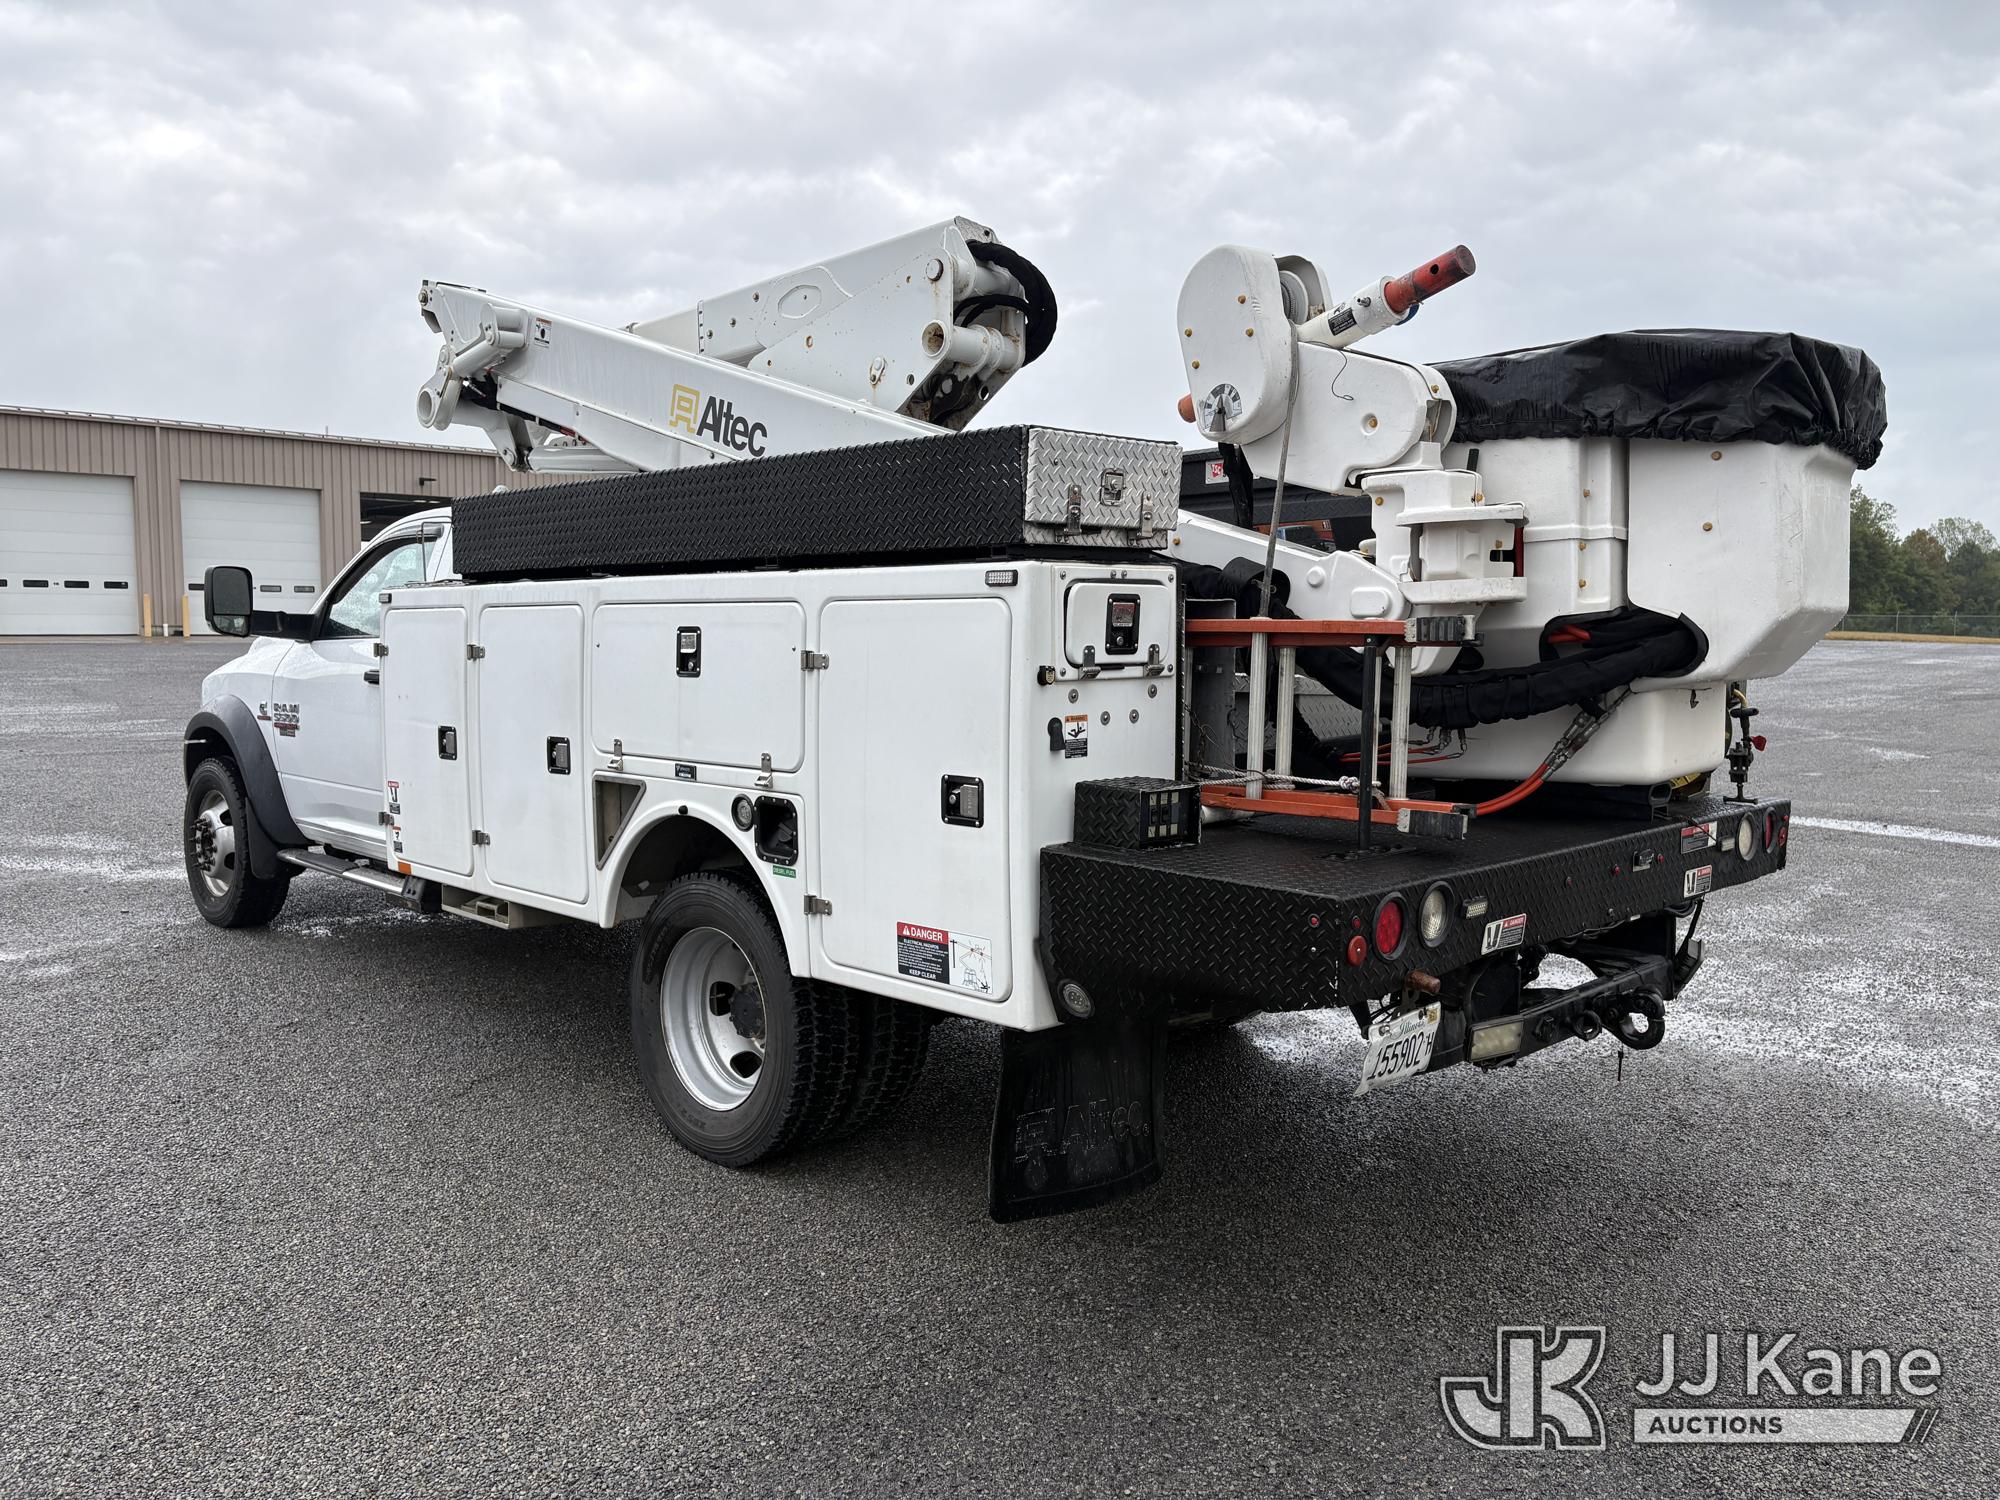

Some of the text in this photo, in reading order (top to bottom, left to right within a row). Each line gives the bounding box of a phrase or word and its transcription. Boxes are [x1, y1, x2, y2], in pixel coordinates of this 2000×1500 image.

[696, 395, 768, 457] Altec
[911, 927, 943, 942] DANGER
[909, 969, 921, 977] KEEP
[1367, 1031, 1424, 1080] 155902
